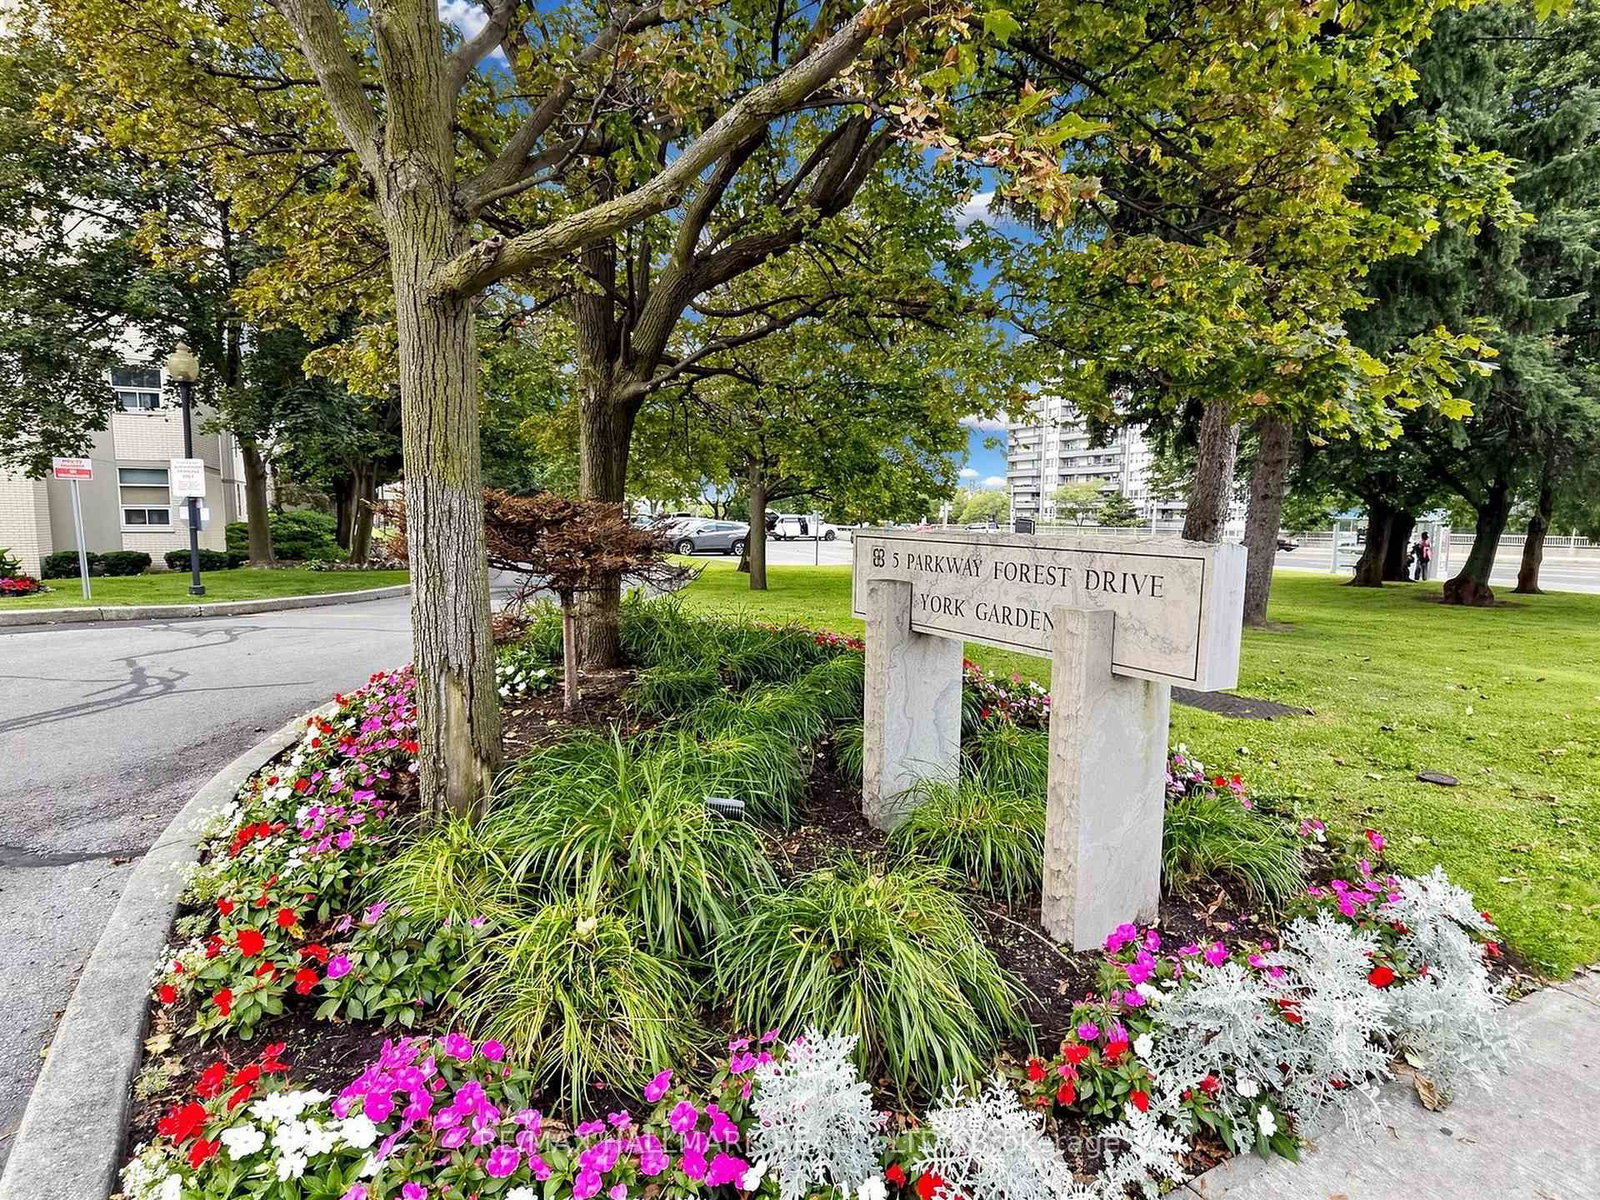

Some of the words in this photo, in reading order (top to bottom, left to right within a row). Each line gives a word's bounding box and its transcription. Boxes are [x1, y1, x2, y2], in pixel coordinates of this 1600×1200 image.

[892, 552, 901, 569] 5
[906, 553, 983, 578] PARKWAY
[993, 560, 1072, 588] FOREST
[1085, 569, 1164, 598] DRIVE
[920, 593, 966, 618] YORK
